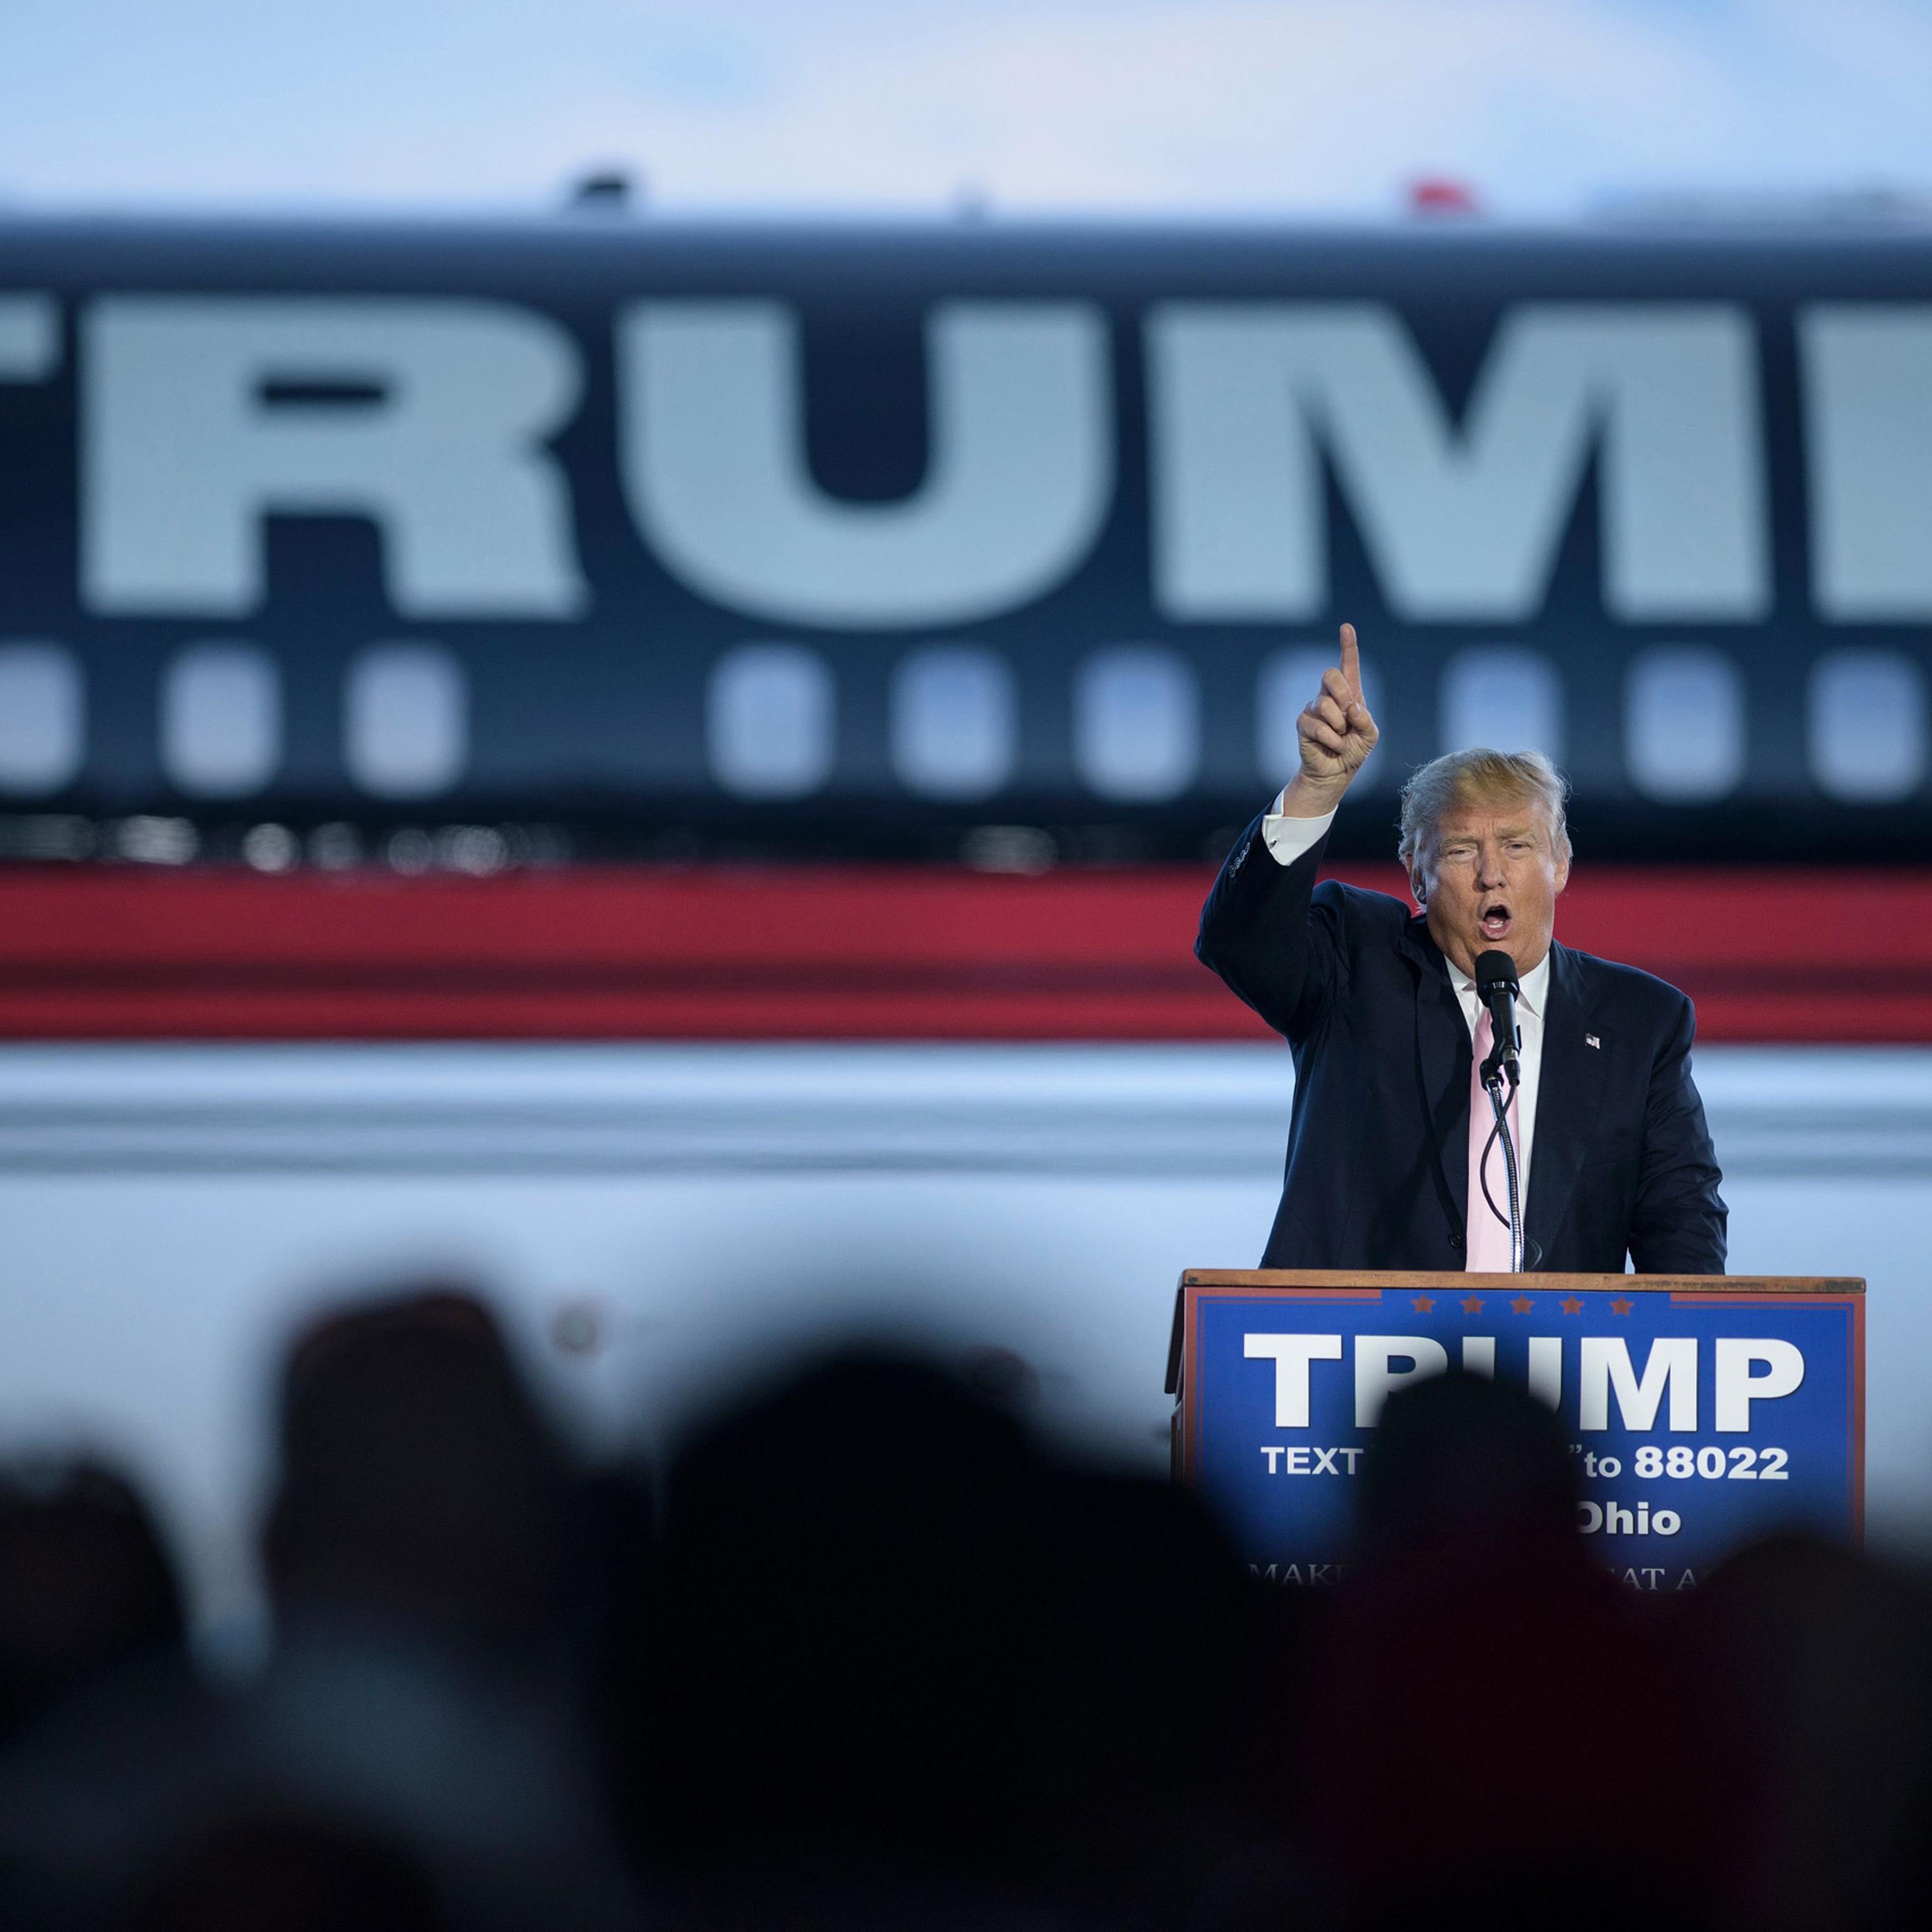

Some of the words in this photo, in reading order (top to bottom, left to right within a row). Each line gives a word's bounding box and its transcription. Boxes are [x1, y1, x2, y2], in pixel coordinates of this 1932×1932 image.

[0, 296, 1932, 628] RUM
[1260, 1446, 1364, 1475] TEXT
[1634, 1445, 1790, 1480] 88022
[1576, 1500, 1681, 1535] Ohio
